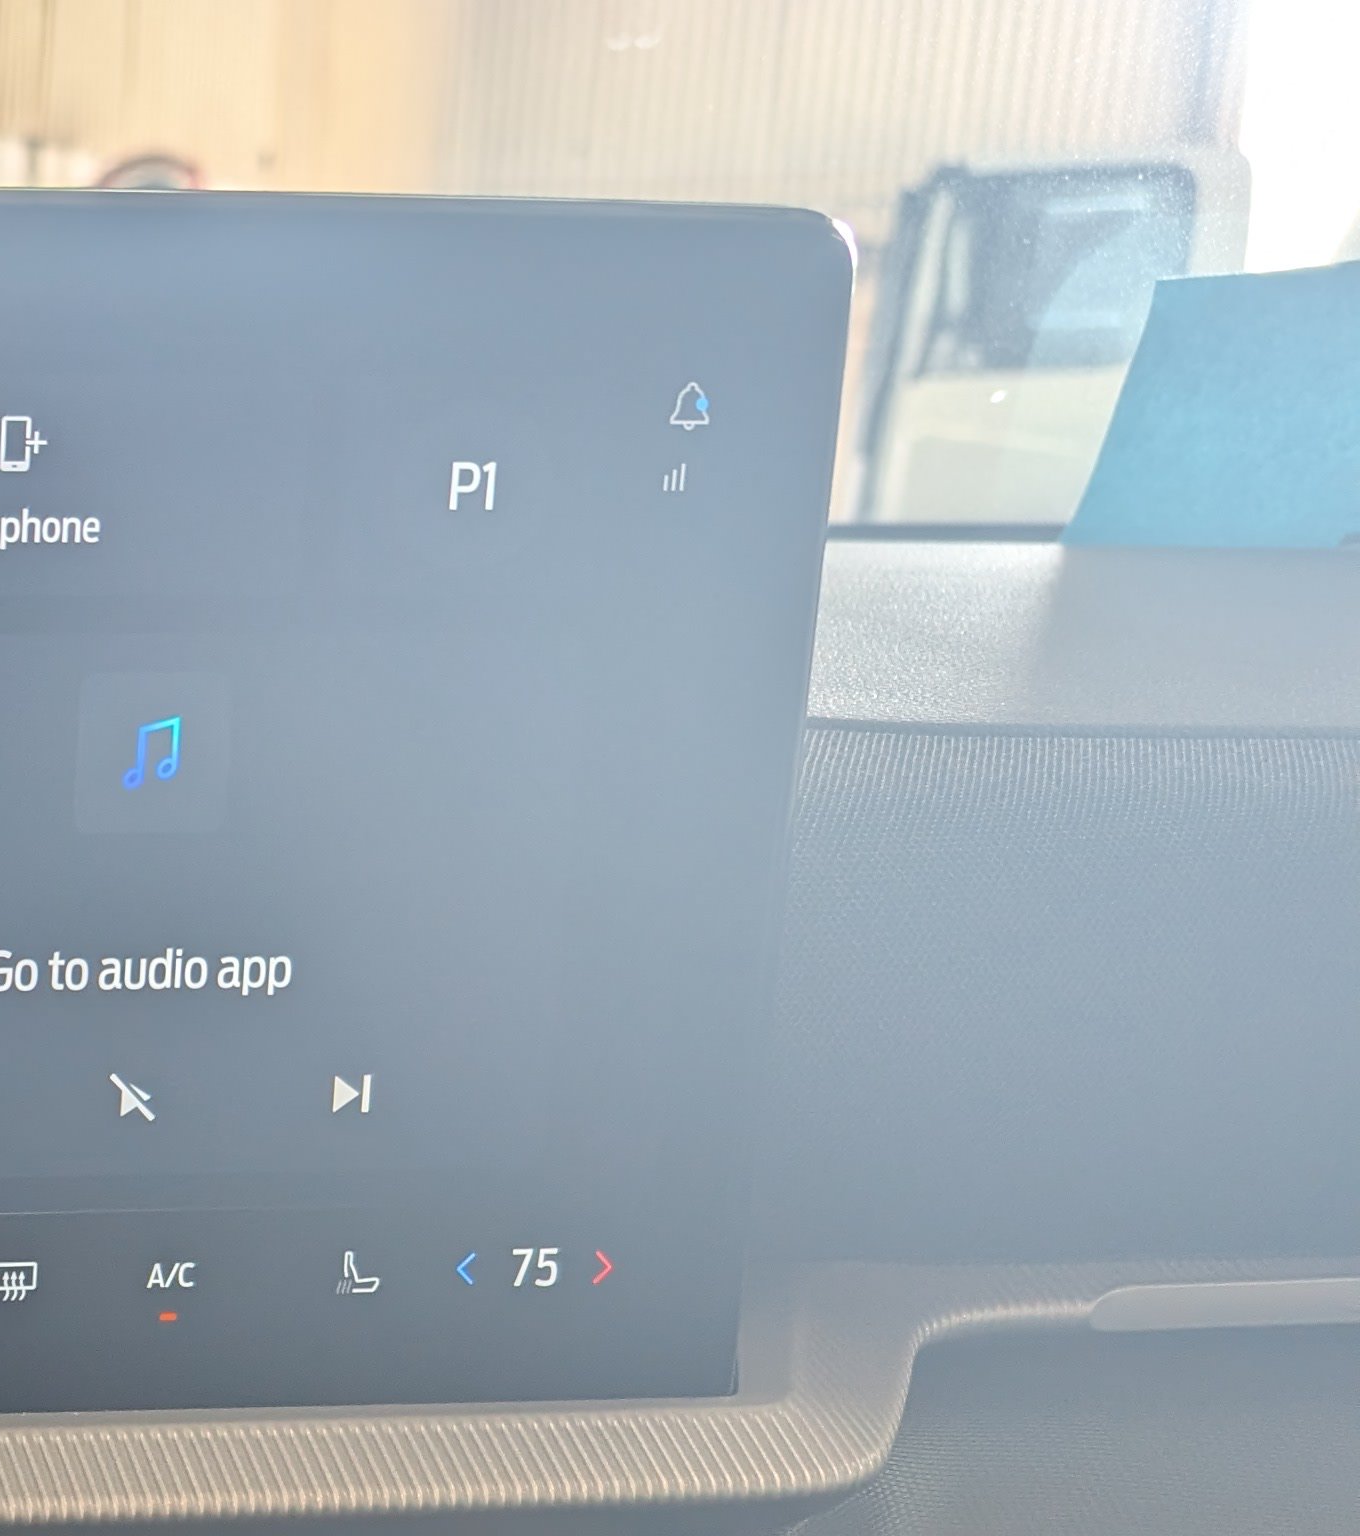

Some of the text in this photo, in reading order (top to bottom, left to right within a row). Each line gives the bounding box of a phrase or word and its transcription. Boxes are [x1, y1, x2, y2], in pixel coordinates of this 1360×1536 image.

[448, 461, 498, 511] P1
[0, 507, 101, 550] phone
[48, 950, 90, 991] to
[98, 947, 209, 991] audio
[217, 955, 293, 996] app
[146, 1261, 196, 1289] A/C
[512, 1247, 559, 1287] 75
